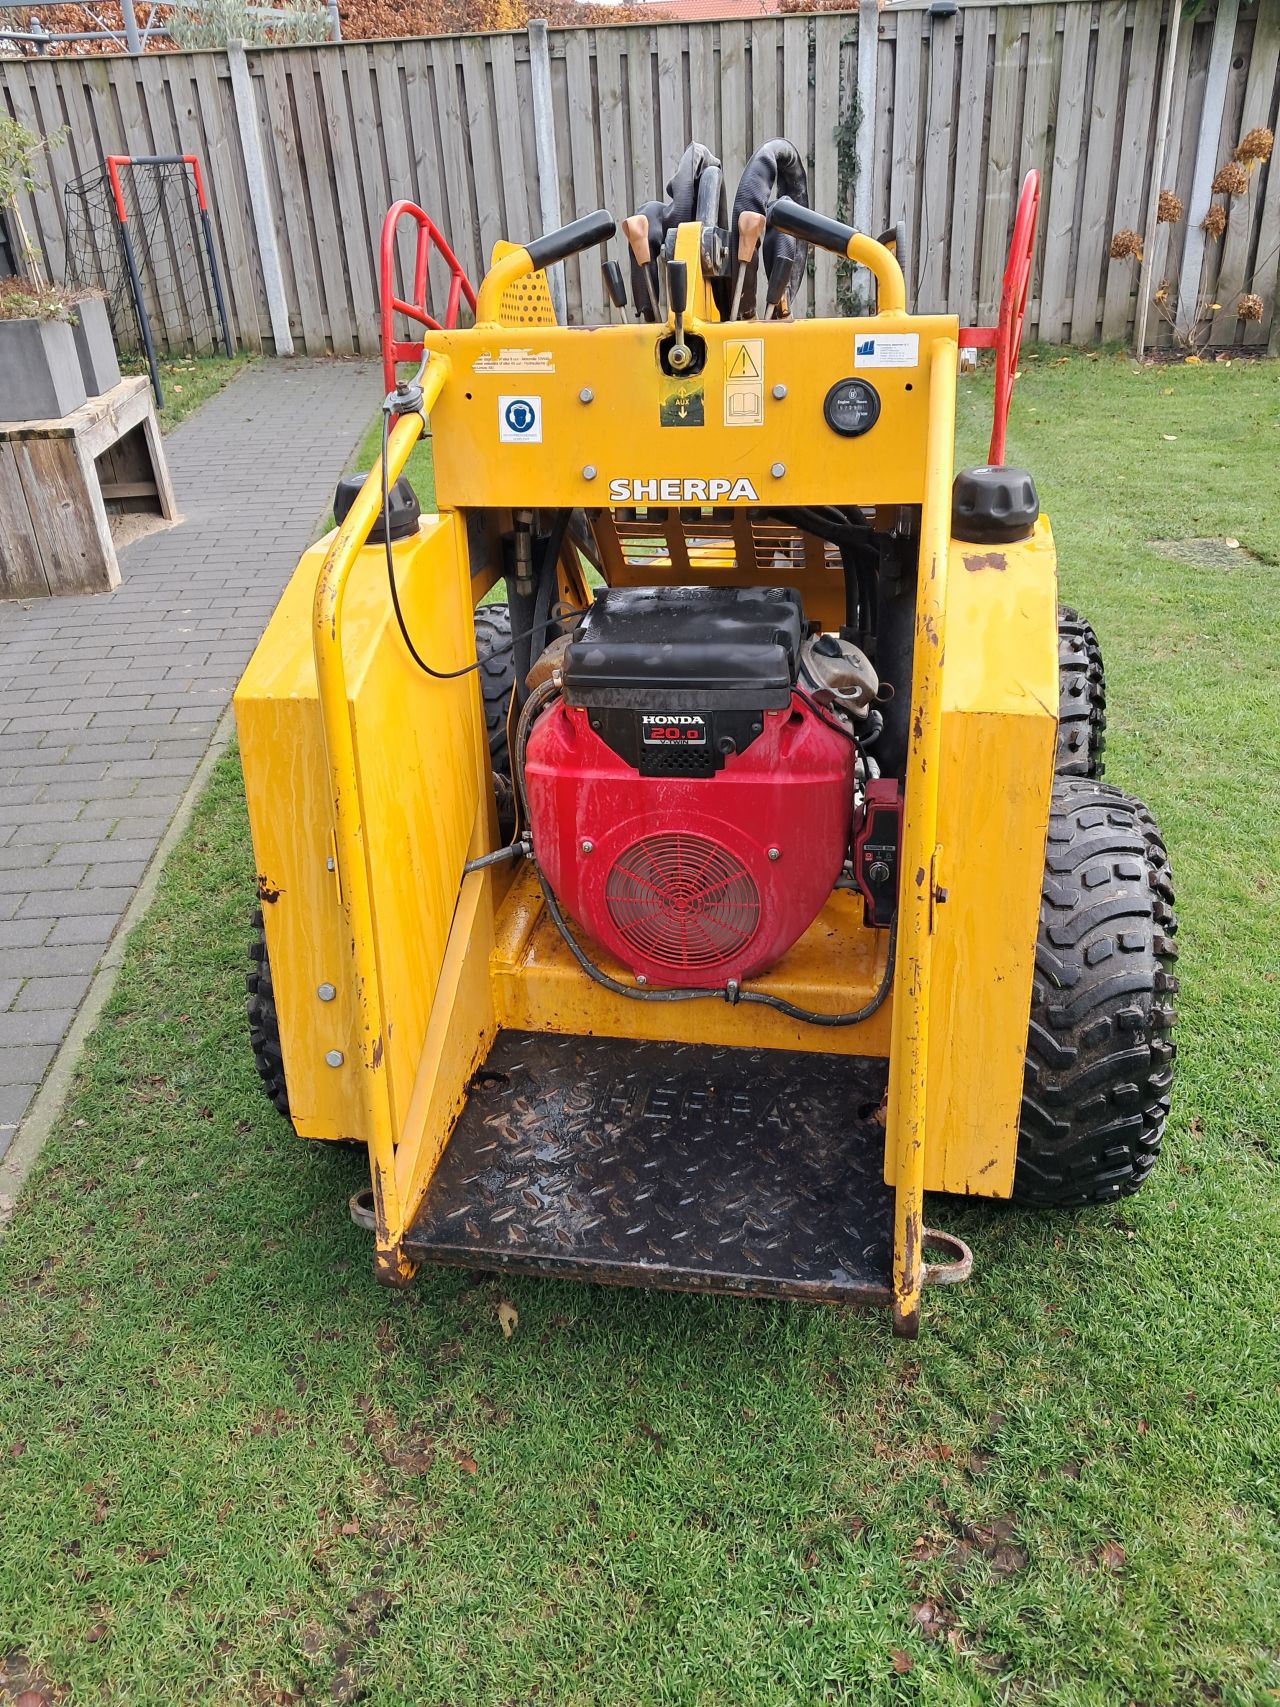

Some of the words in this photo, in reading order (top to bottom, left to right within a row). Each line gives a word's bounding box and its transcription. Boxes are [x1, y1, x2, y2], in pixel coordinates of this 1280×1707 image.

[608, 478, 760, 501] SHERPA
[641, 715, 705, 724] HONDA
[651, 727, 699, 739] 20.0
